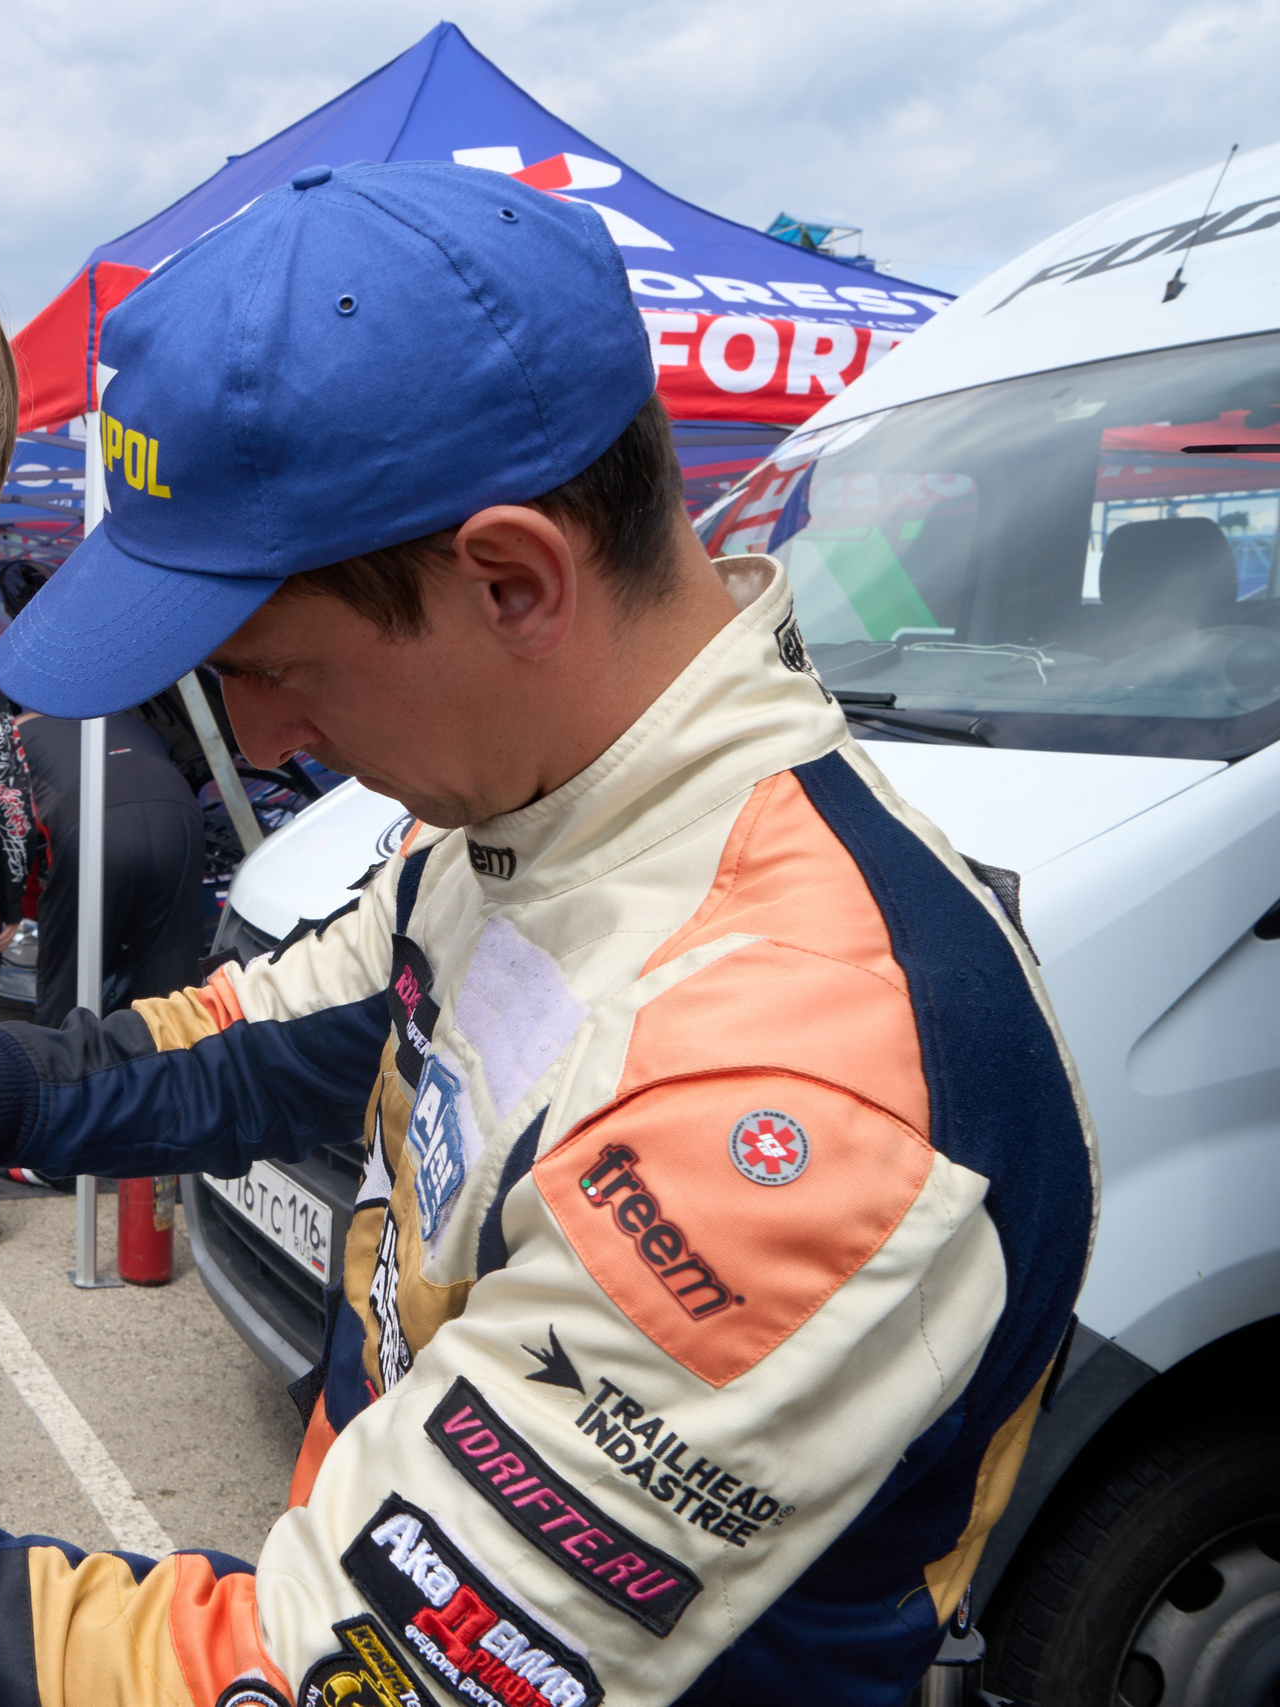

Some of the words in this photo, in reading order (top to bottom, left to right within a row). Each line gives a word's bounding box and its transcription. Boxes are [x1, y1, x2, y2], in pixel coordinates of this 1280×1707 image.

[288, 1194, 321, 1250] 116
[293, 1236, 311, 1262] RUS
[442, 1405, 680, 1602] VDRIFTE.RU
[574, 1402, 761, 1548] INDASTREE
[404, 1624, 461, 1685] ФЕДОРА
